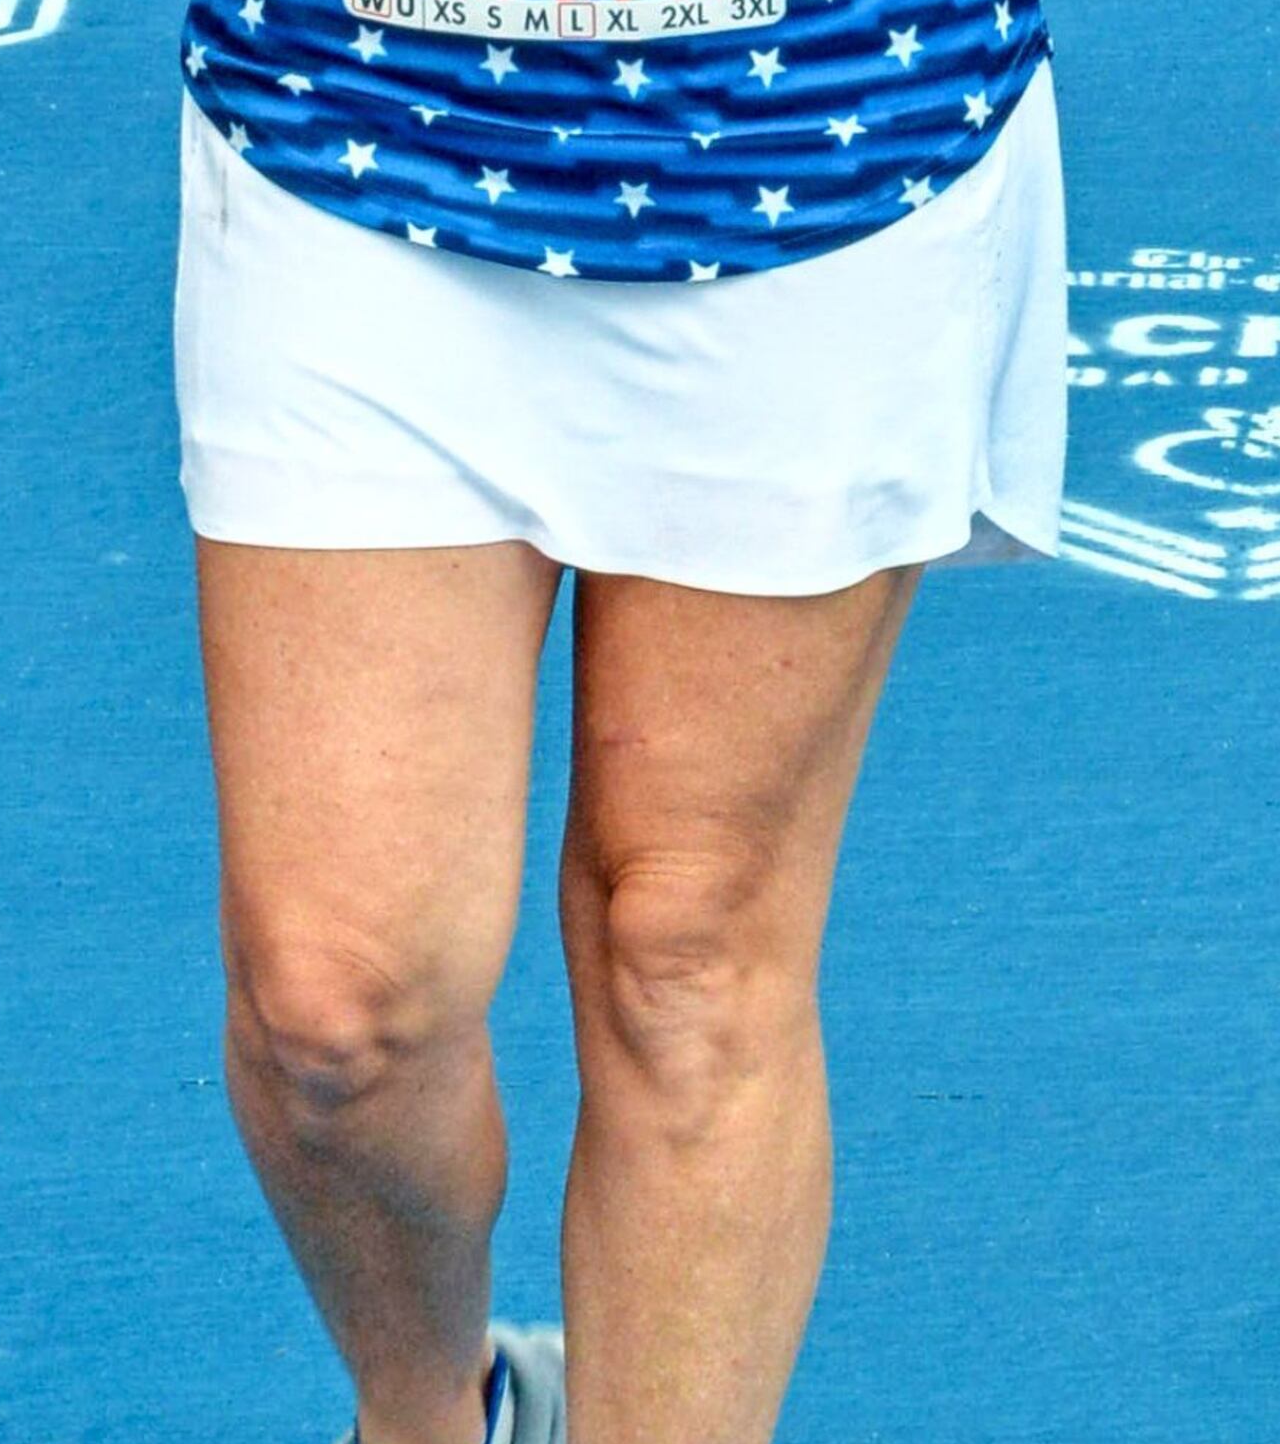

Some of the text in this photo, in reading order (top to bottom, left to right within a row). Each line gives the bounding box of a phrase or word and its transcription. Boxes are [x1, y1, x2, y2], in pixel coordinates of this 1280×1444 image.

[433, 0, 466, 25] XS
[487, 5, 502, 30] S
[524, 7, 550, 32] M
[571, 8, 583, 31] L
[606, 7, 639, 32] XL
[661, 2, 709, 30] 2XL
[1067, 366, 1249, 389] OAD
